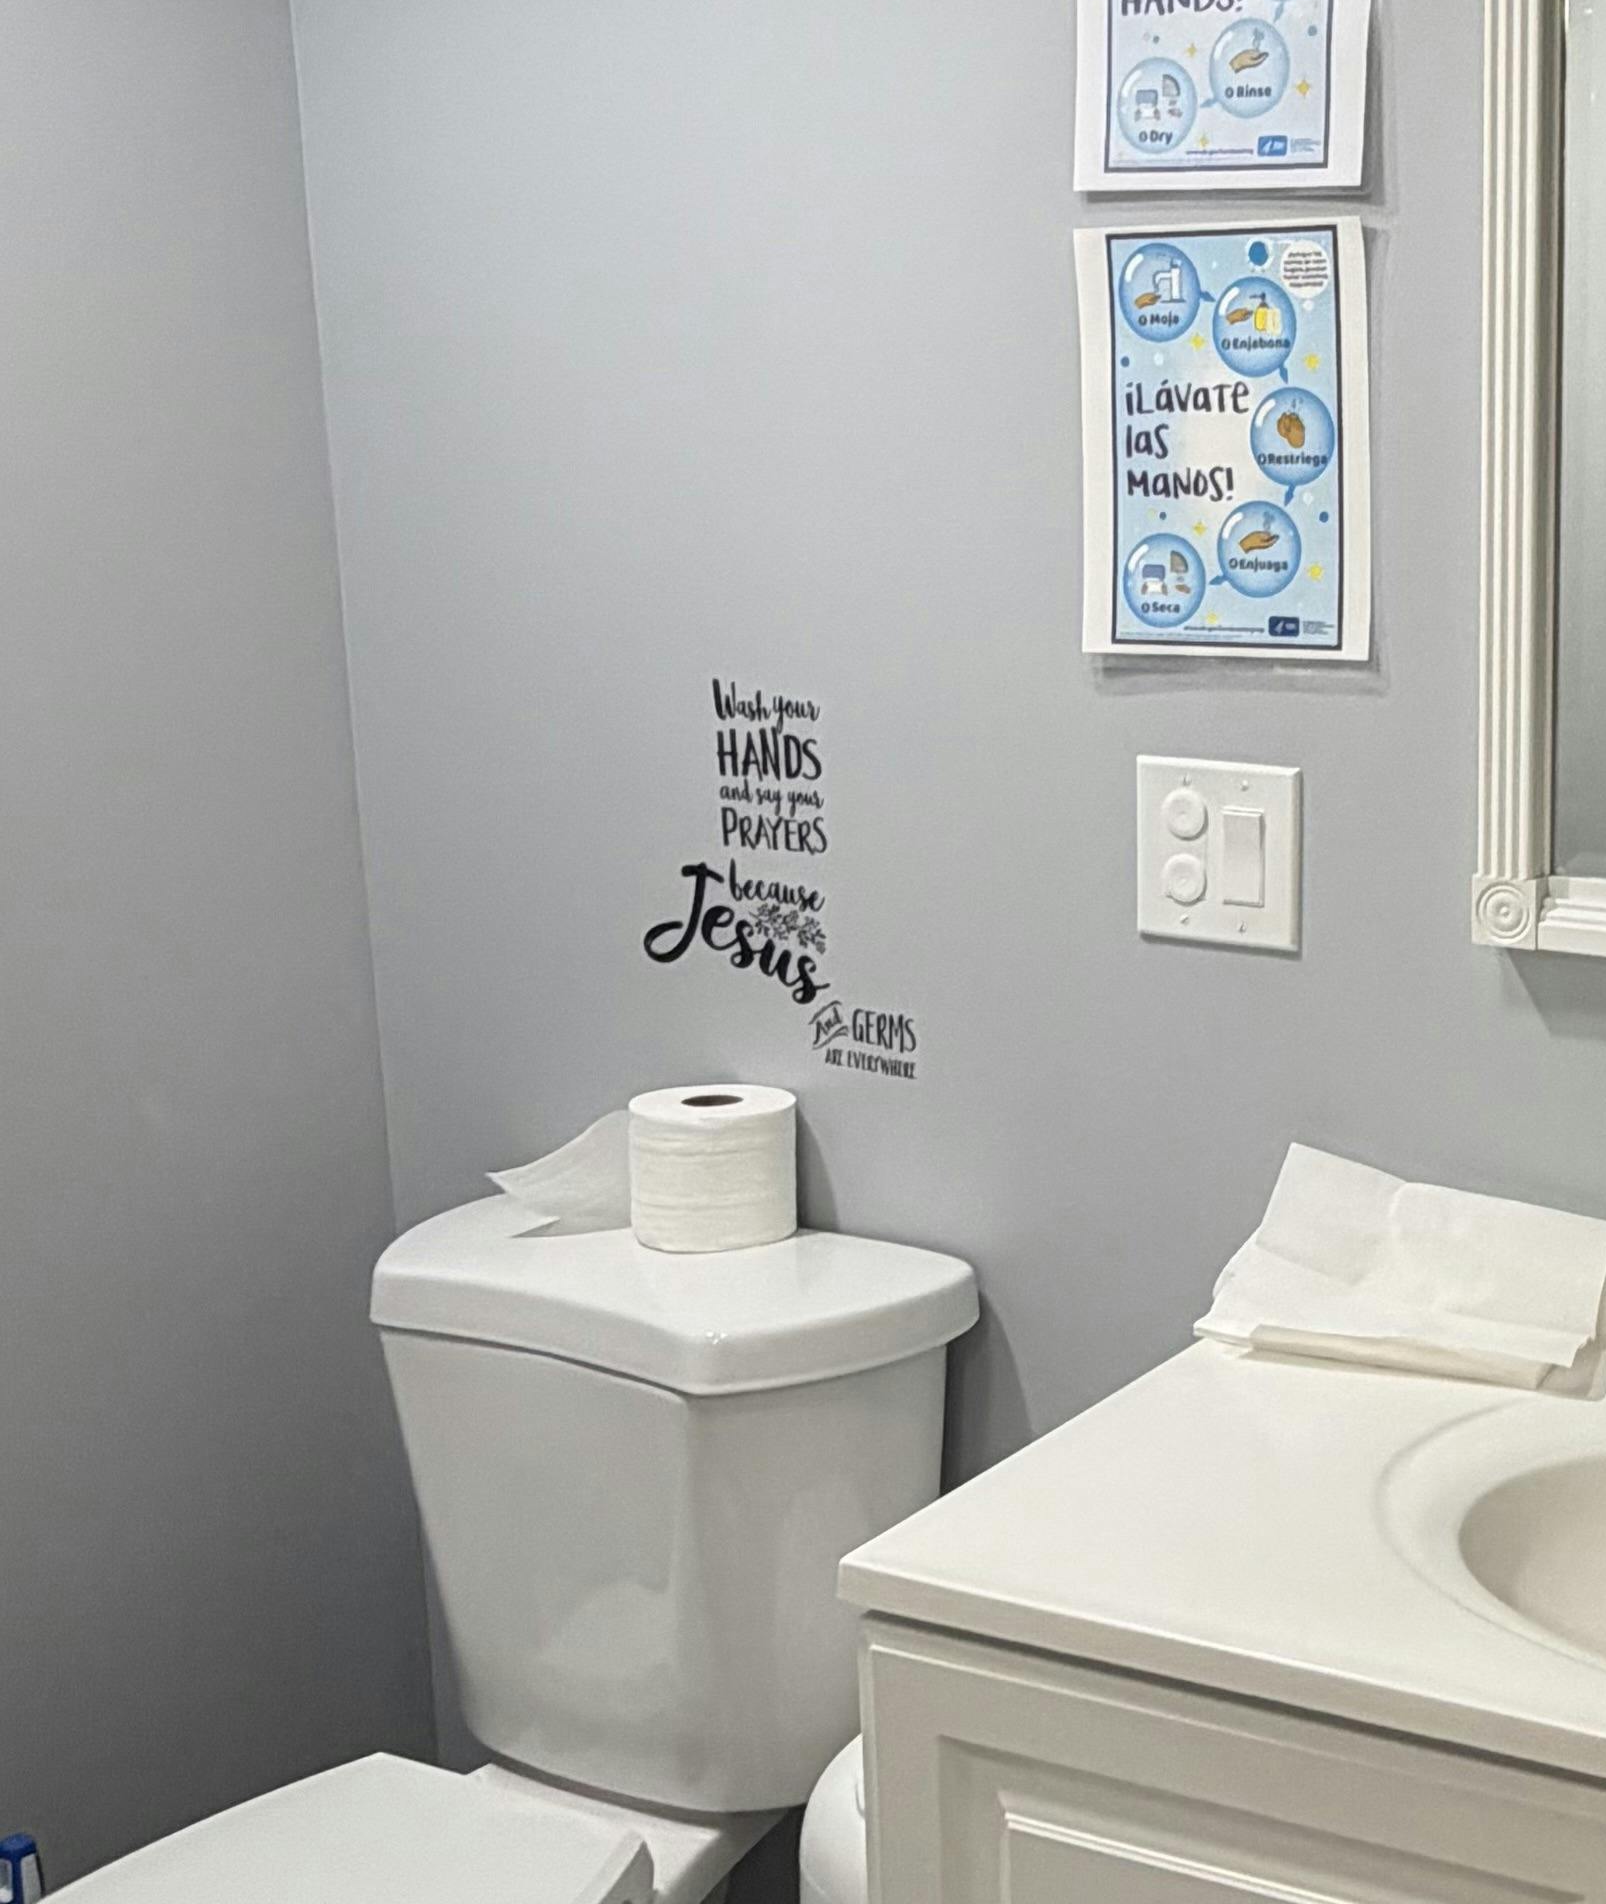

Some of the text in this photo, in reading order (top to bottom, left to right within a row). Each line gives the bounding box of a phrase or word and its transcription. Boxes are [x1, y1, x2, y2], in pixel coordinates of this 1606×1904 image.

[1237, 84, 1272, 98] Rinse
[1150, 131, 1174, 145] Dry
[1150, 312, 1180, 328] Moja
[1233, 336, 1291, 352] Enjabona
[1125, 423, 1169, 460] las
[1268, 452, 1329, 467] Restriega
[1241, 557, 1289, 572] Enjuaga
[1152, 603, 1181, 614] Seca
[711, 677, 821, 733] Wash your
[716, 726, 823, 781] HANDS
[719, 777, 825, 819] and say your
[720, 806, 829, 855] PRAYERS
[729, 858, 825, 912] because
[643, 862, 830, 1005] Jesus
[813, 1006, 917, 1053] And GERMS
[824, 1047, 918, 1080] ARE EVERYWHERE
